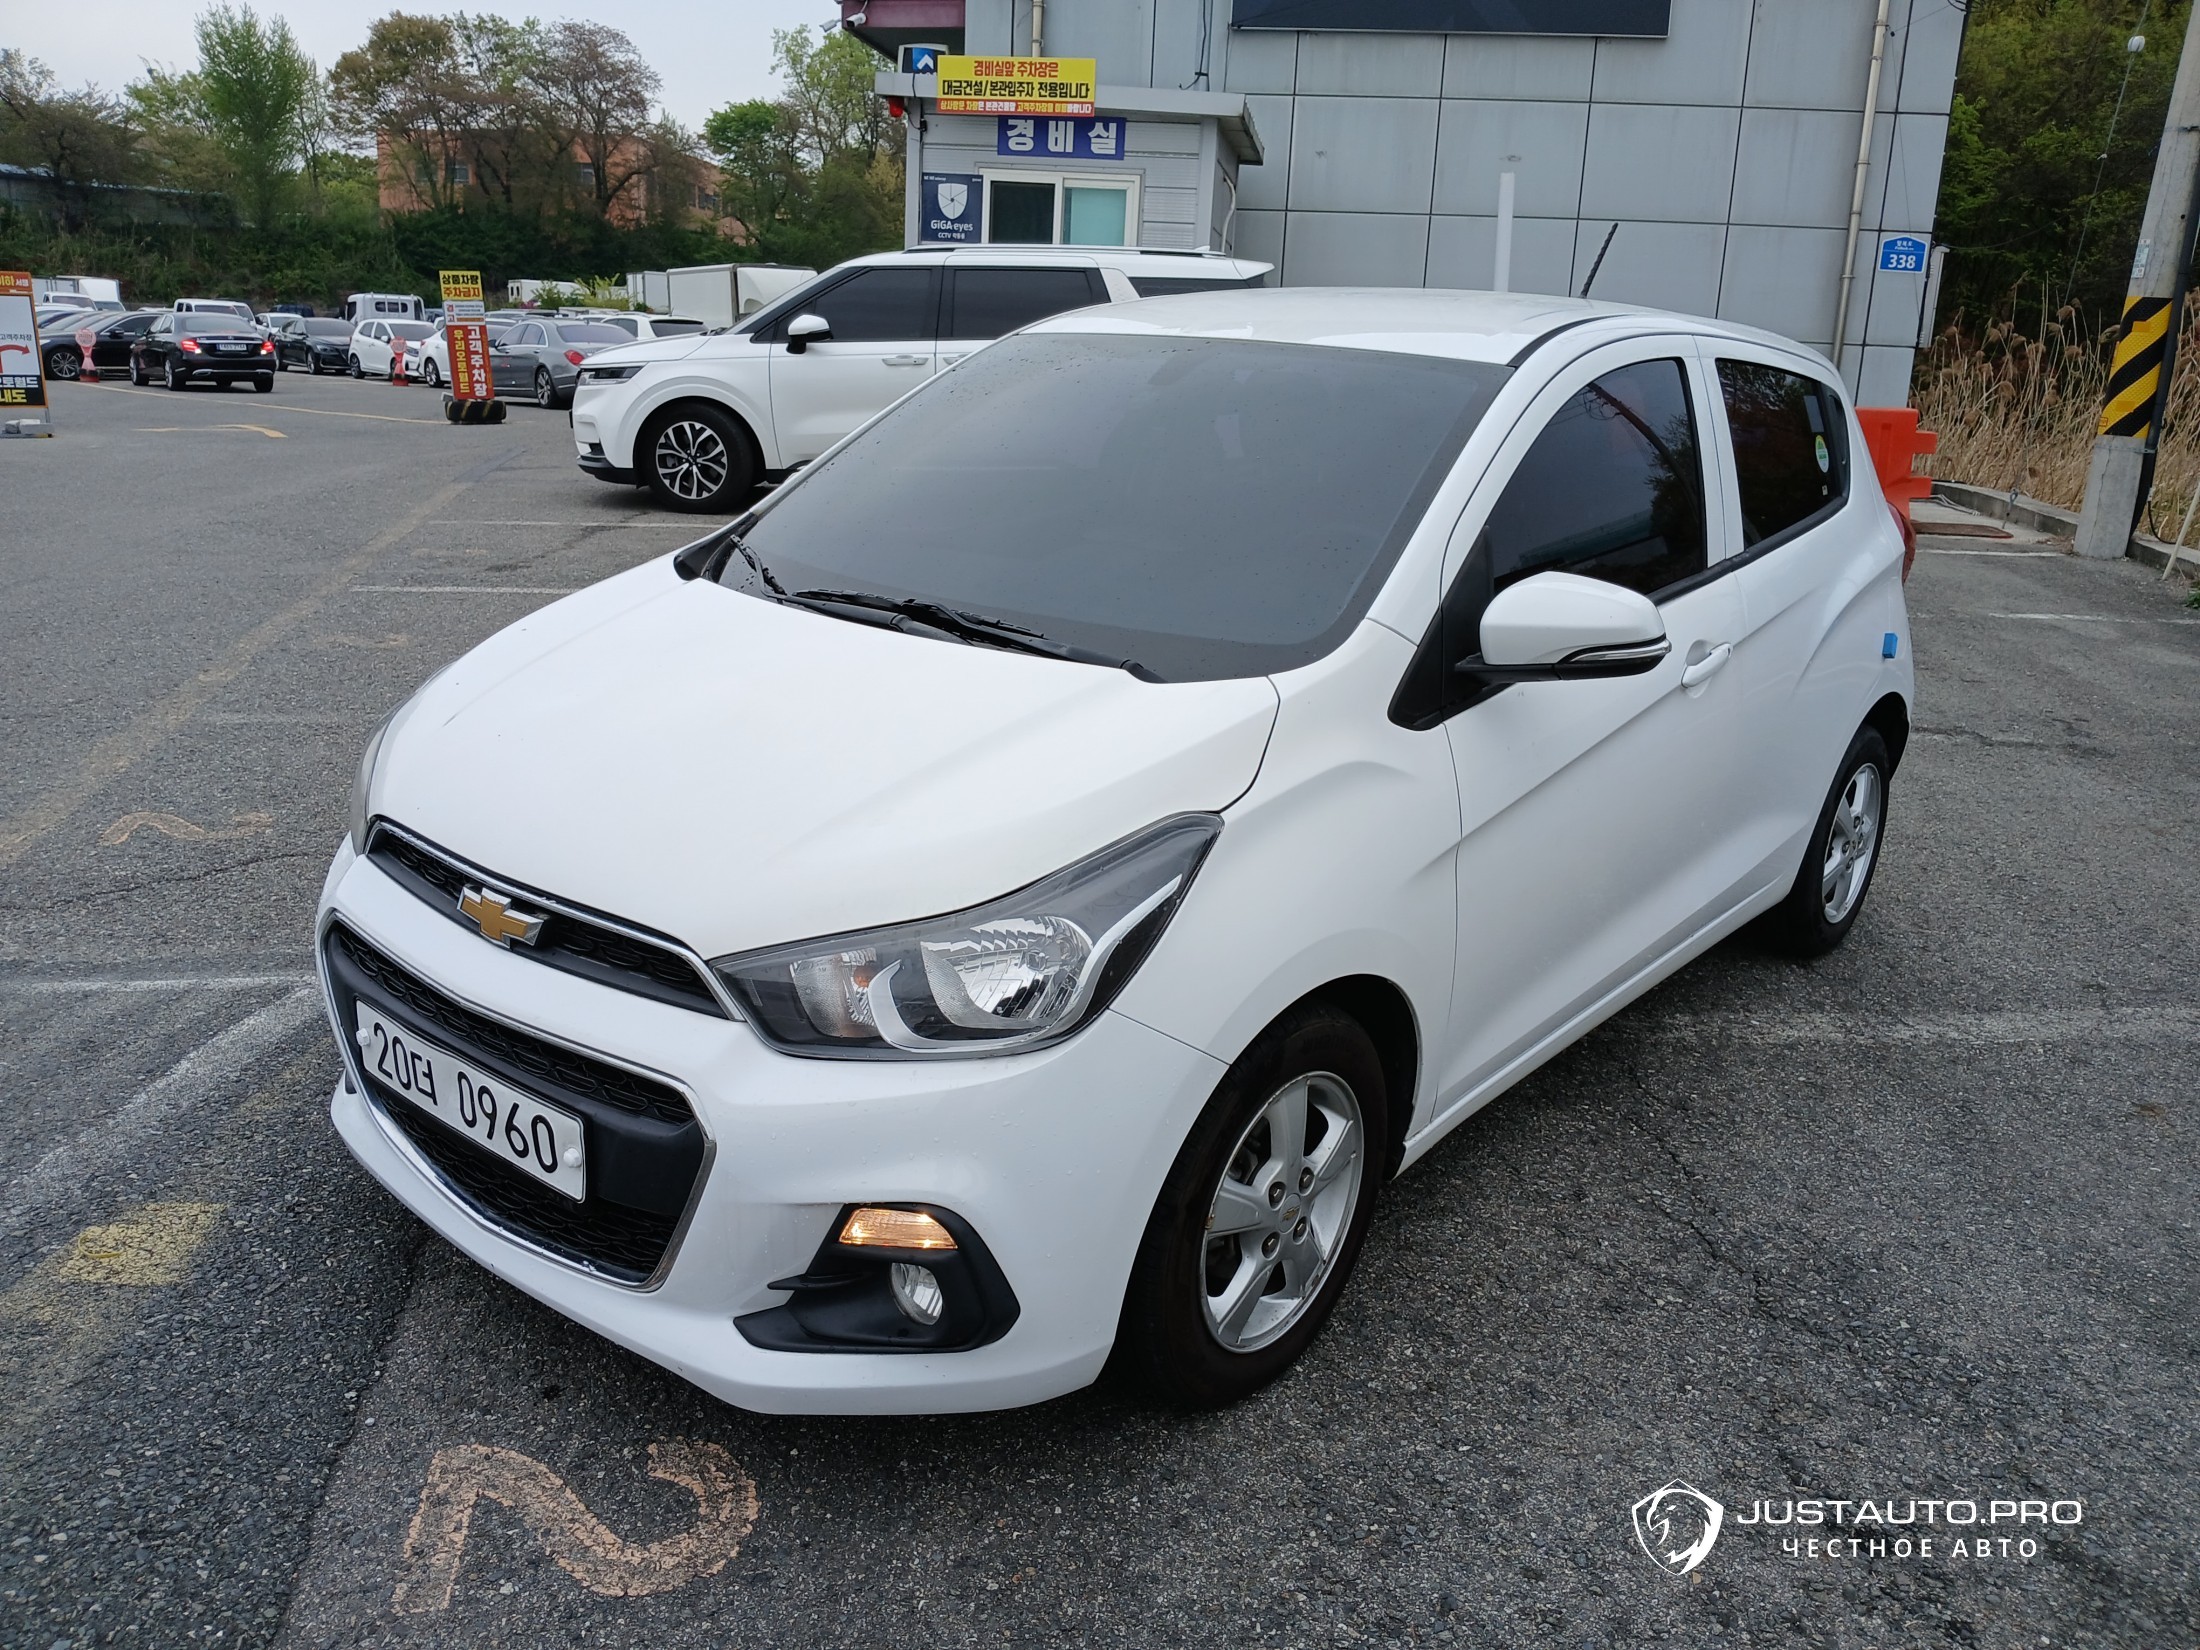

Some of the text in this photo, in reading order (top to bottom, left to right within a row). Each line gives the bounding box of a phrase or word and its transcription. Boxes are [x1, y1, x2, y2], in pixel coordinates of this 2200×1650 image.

[974, 60, 1059, 78] 경비실앞 주차장은
[1037, 82, 1090, 99] 전용입니다
[937, 231, 952, 239] CCTV
[1888, 254, 1916, 269] 338
[442, 274, 479, 285] 상품차량
[443, 286, 481, 298] 주차금지
[467, 325, 488, 397] 고객주차장
[0, 376, 39, 389] 토월드
[373, 1022, 558, 1174] 20더 0960
